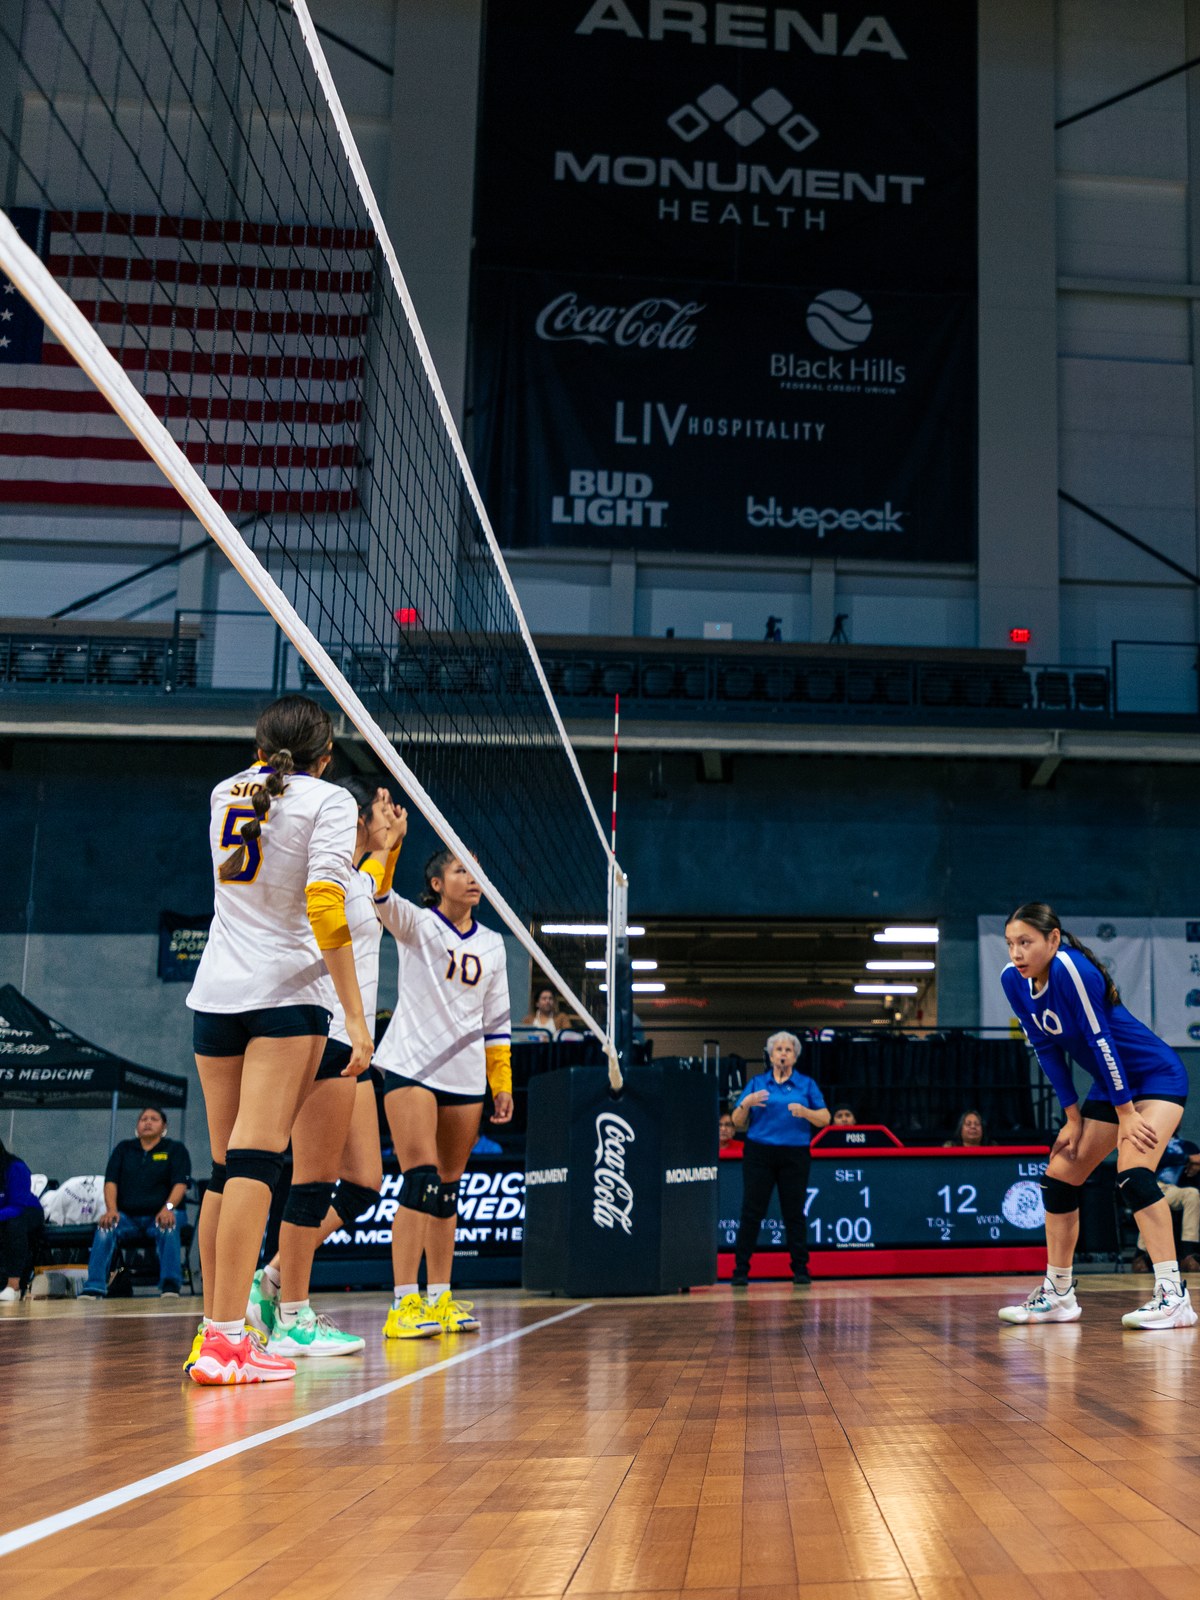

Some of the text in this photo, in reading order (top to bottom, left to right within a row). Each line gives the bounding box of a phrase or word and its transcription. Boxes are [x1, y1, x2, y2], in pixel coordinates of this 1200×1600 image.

[574, 0, 908, 60] ARENA
[554, 150, 925, 205] MONUMENT
[658, 199, 825, 231] HEALTH
[770, 353, 906, 384] Black Hills
[615, 401, 825, 446] LIV HOSPITALITY
[569, 469, 653, 499] BUD
[552, 496, 668, 528] LIGHT
[747, 495, 903, 538] bluepeak
[219, 804, 269, 885] 5
[446, 947, 482, 986] 10
[1031, 1008, 1063, 1036] 10
[18, 1068, 94, 1081] MEDICINE
[846, 1133, 866, 1144] POSS
[525, 1168, 569, 1186] MONUMENT
[668, 1166, 719, 1184] MONUMENT
[835, 1169, 863, 1182] SET
[859, 1186, 870, 1208] 1
[937, 1185, 978, 1214] 12
[771, 1230, 782, 1244] 2
[941, 1227, 951, 1241] 2
[990, 1226, 1000, 1240] 0
[809, 1217, 873, 1243] 1:00
